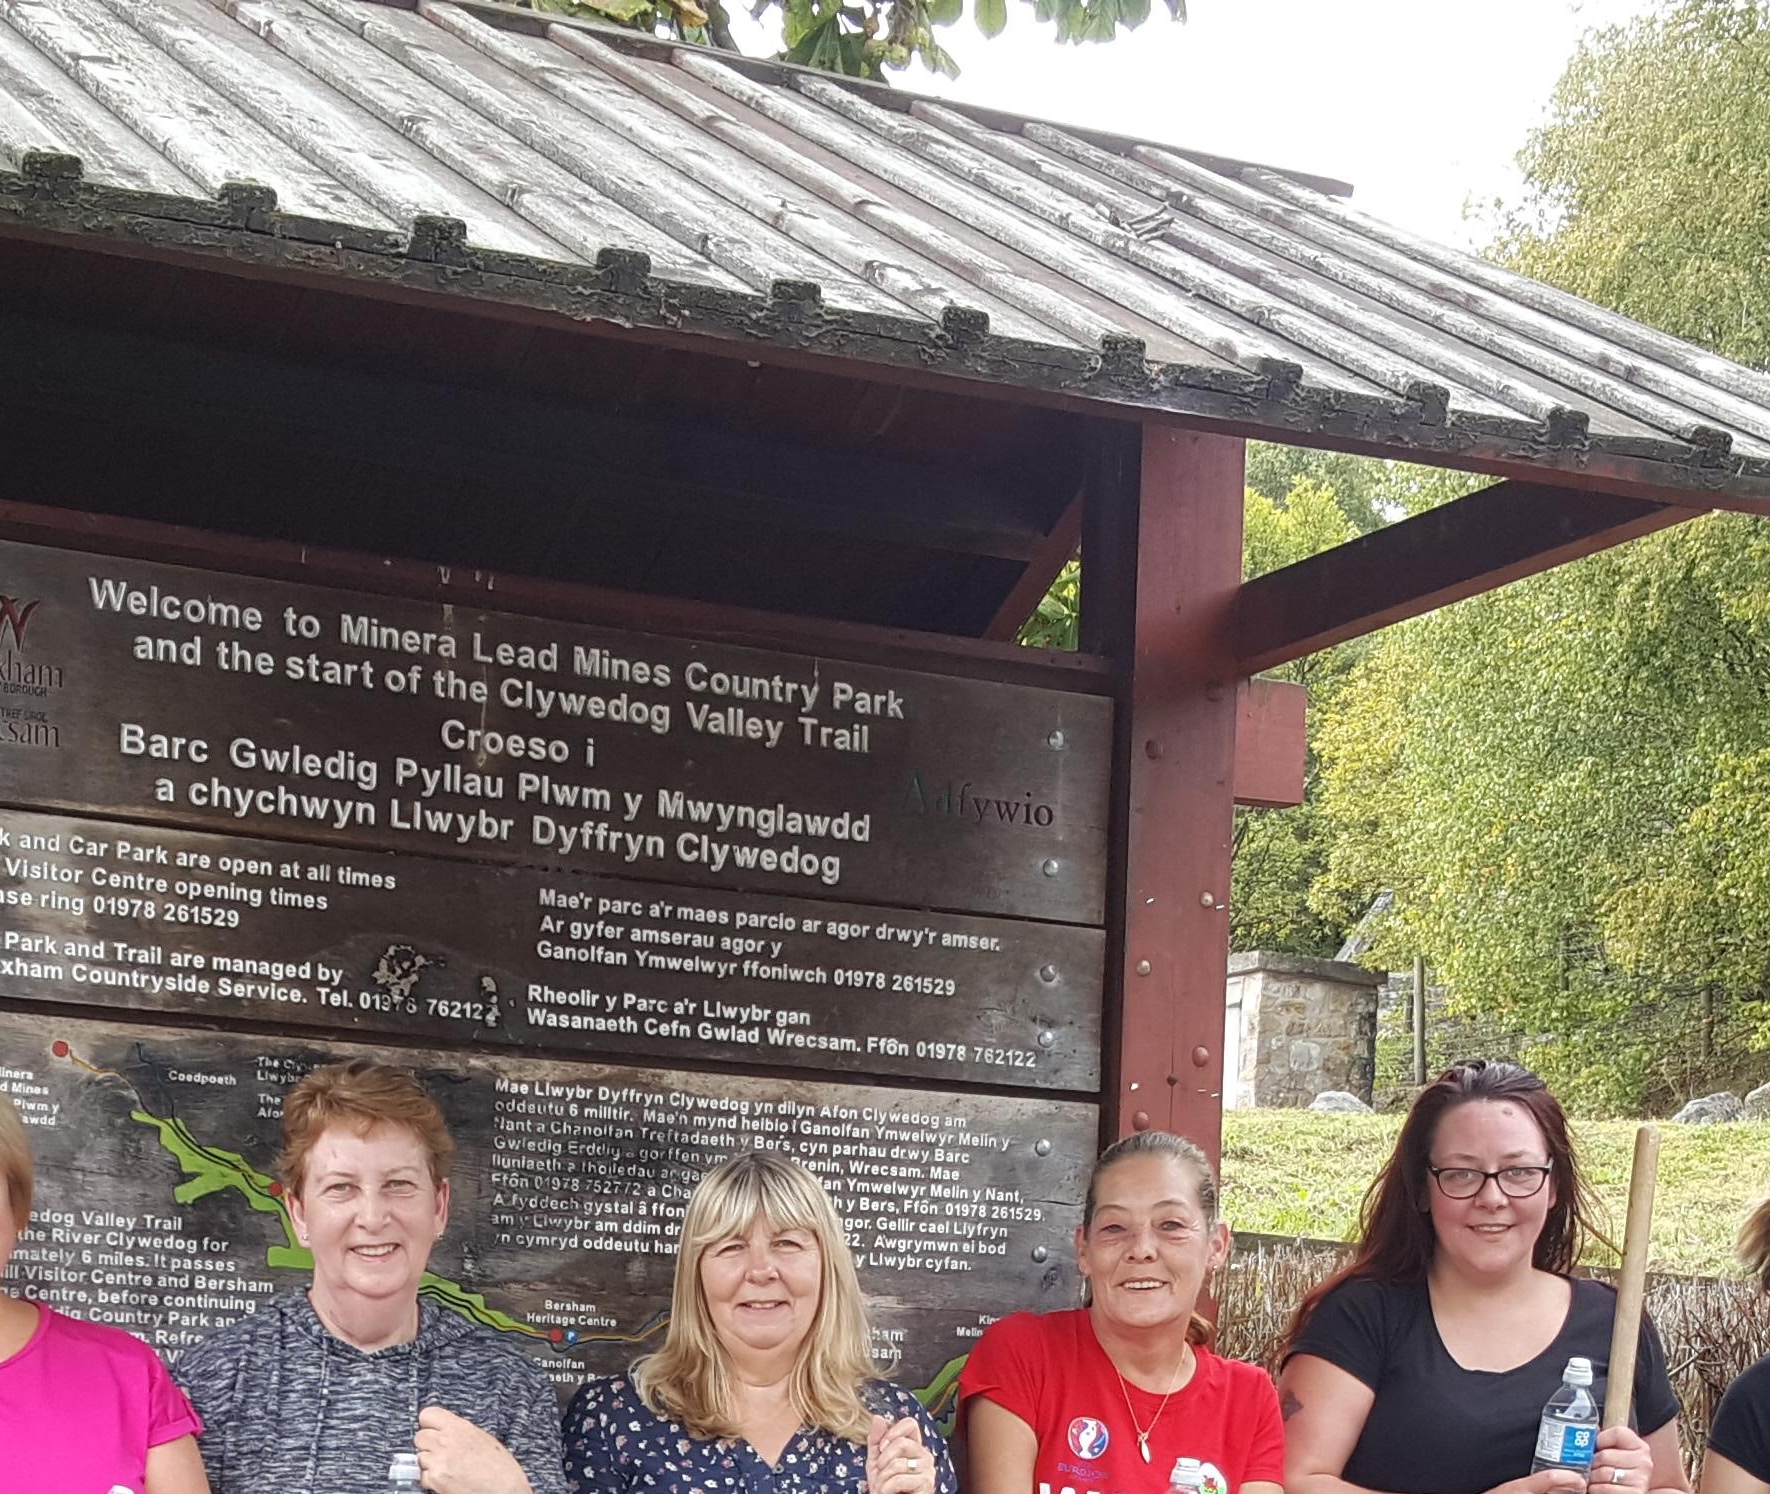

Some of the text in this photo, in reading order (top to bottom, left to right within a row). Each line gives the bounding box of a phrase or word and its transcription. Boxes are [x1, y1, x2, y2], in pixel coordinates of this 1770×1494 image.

[89, 577, 903, 719] Welcome to Minera Lead Mines Country Park
[134, 635, 868, 753] and the start of the Clywedog Valley Trail
[442, 719, 593, 767] Croeso i
[121, 723, 869, 842] Barc Gwledig Pyllau Plwm y Mwynglawdd
[156, 777, 839, 885] a chychwyn Llwybr Dyffryn Clywedog
[5, 857, 83, 883] Visitor
[92, 866, 167, 892] Centre
[175, 881, 261, 907] opening
[270, 887, 327, 910] times
[20, 833, 60, 852] and
[69, 835, 108, 857] Car
[117, 841, 167, 865] Park
[176, 851, 210, 869] are
[219, 857, 272, 876] open
[280, 861, 299, 879] at
[307, 864, 330, 881] all
[338, 867, 395, 889] times
[41, 890, 84, 916] ring
[94, 895, 155, 919] 01978
[164, 903, 239, 927] 261529
[540, 888, 1000, 952] Mae'r parc a'r maes parcio ar agor drwy'r amser.
[5, 931, 57, 955] Park
[64, 940, 104, 960] and
[114, 942, 161, 964] Trail
[171, 952, 205, 968] are
[213, 956, 310, 981] managed
[318, 963, 343, 986] by
[541, 915, 782, 959] Ar gyfer amserau agor y
[72, 963, 210, 994] Countryside
[218, 977, 307, 1004] Service.
[316, 987, 352, 1007] Tel.
[537, 940, 955, 995] Ganolfan Ymwelwyr ffoniwch 01978 261529
[529, 984, 810, 1027] Rheolir y Parc a'r Llwybr gan
[527, 1008, 1035, 1068] Wasanaeth Cefn Gwlad Wrecsam. Ffôn 01978 762122
[495, 1078, 967, 1129] Mae Llwybr Dyffryn Clywedog yn dilyn Afon Clywedog am
[569, 1103, 578, 1117] 6
[644, 1108, 687, 1125] Mae'n
[694, 1115, 736, 1130] mynd
[875, 1125, 954, 1147] Ymwelwyr
[959, 1131, 996, 1148] Melin
[1002, 1137, 1009, 1152] y
[52, 1227, 228, 1254] River Clywedog for
[82, 1210, 181, 1232] Valley Trail
[25, 1265, 273, 1293] Visitor Centre and Bersham
[82, 1249, 91, 1264] 6
[171, 1257, 235, 1272] passes
[25, 1284, 256, 1314] Centre, before continuing
[544, 1299, 597, 1314] Bersham
